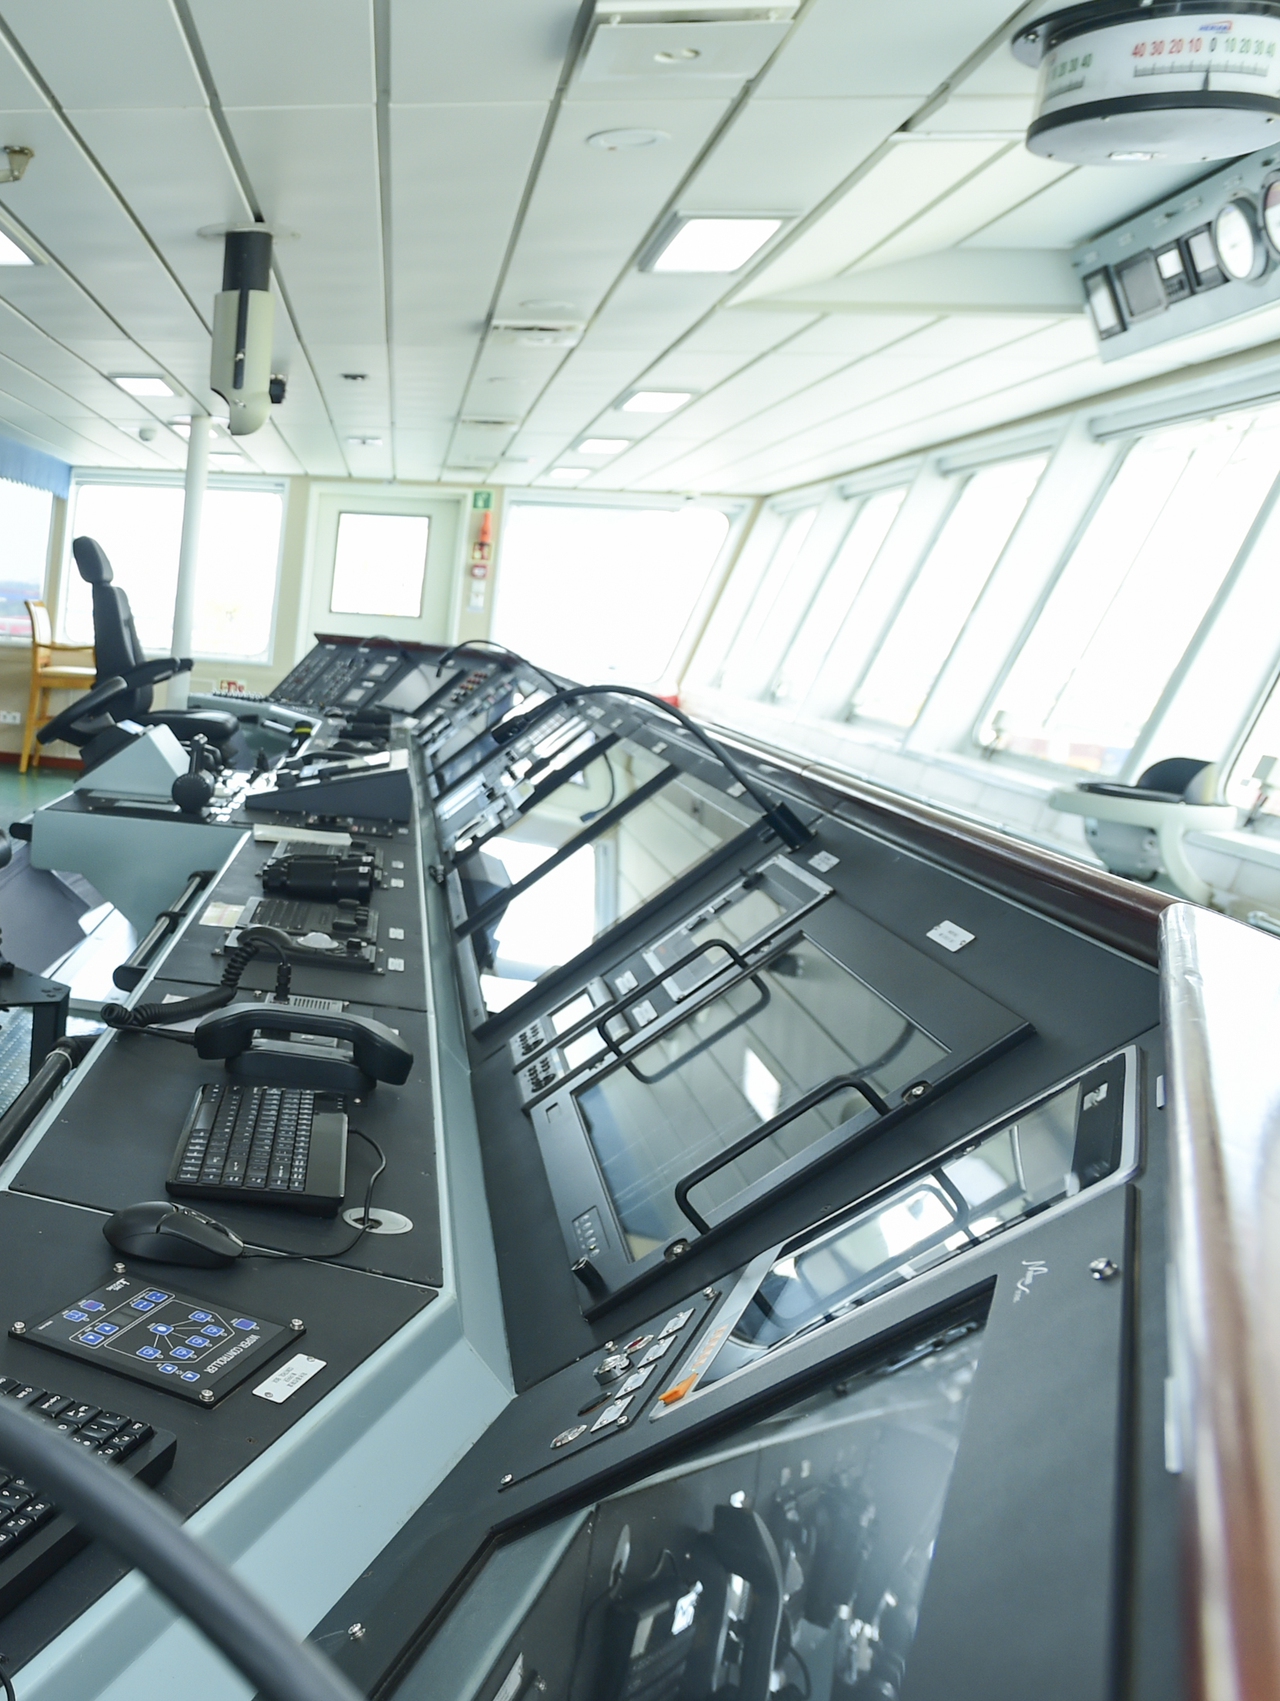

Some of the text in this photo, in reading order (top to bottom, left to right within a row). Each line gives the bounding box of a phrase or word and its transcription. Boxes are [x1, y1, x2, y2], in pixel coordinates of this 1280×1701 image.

[1131, 42, 1146, 57] 40
[1150, 40, 1165, 56] 30
[1168, 38, 1184, 54] 20
[1189, 37, 1203, 53] 10
[1209, 37, 1218, 52] 0
[1225, 37, 1237, 52] 10
[1239, 38, 1252, 54] 20
[1253, 39, 1265, 55] 30
[1081, 53, 1093, 68] 40
[203, 1334, 261, 1374] WIPER CONTROLLER
